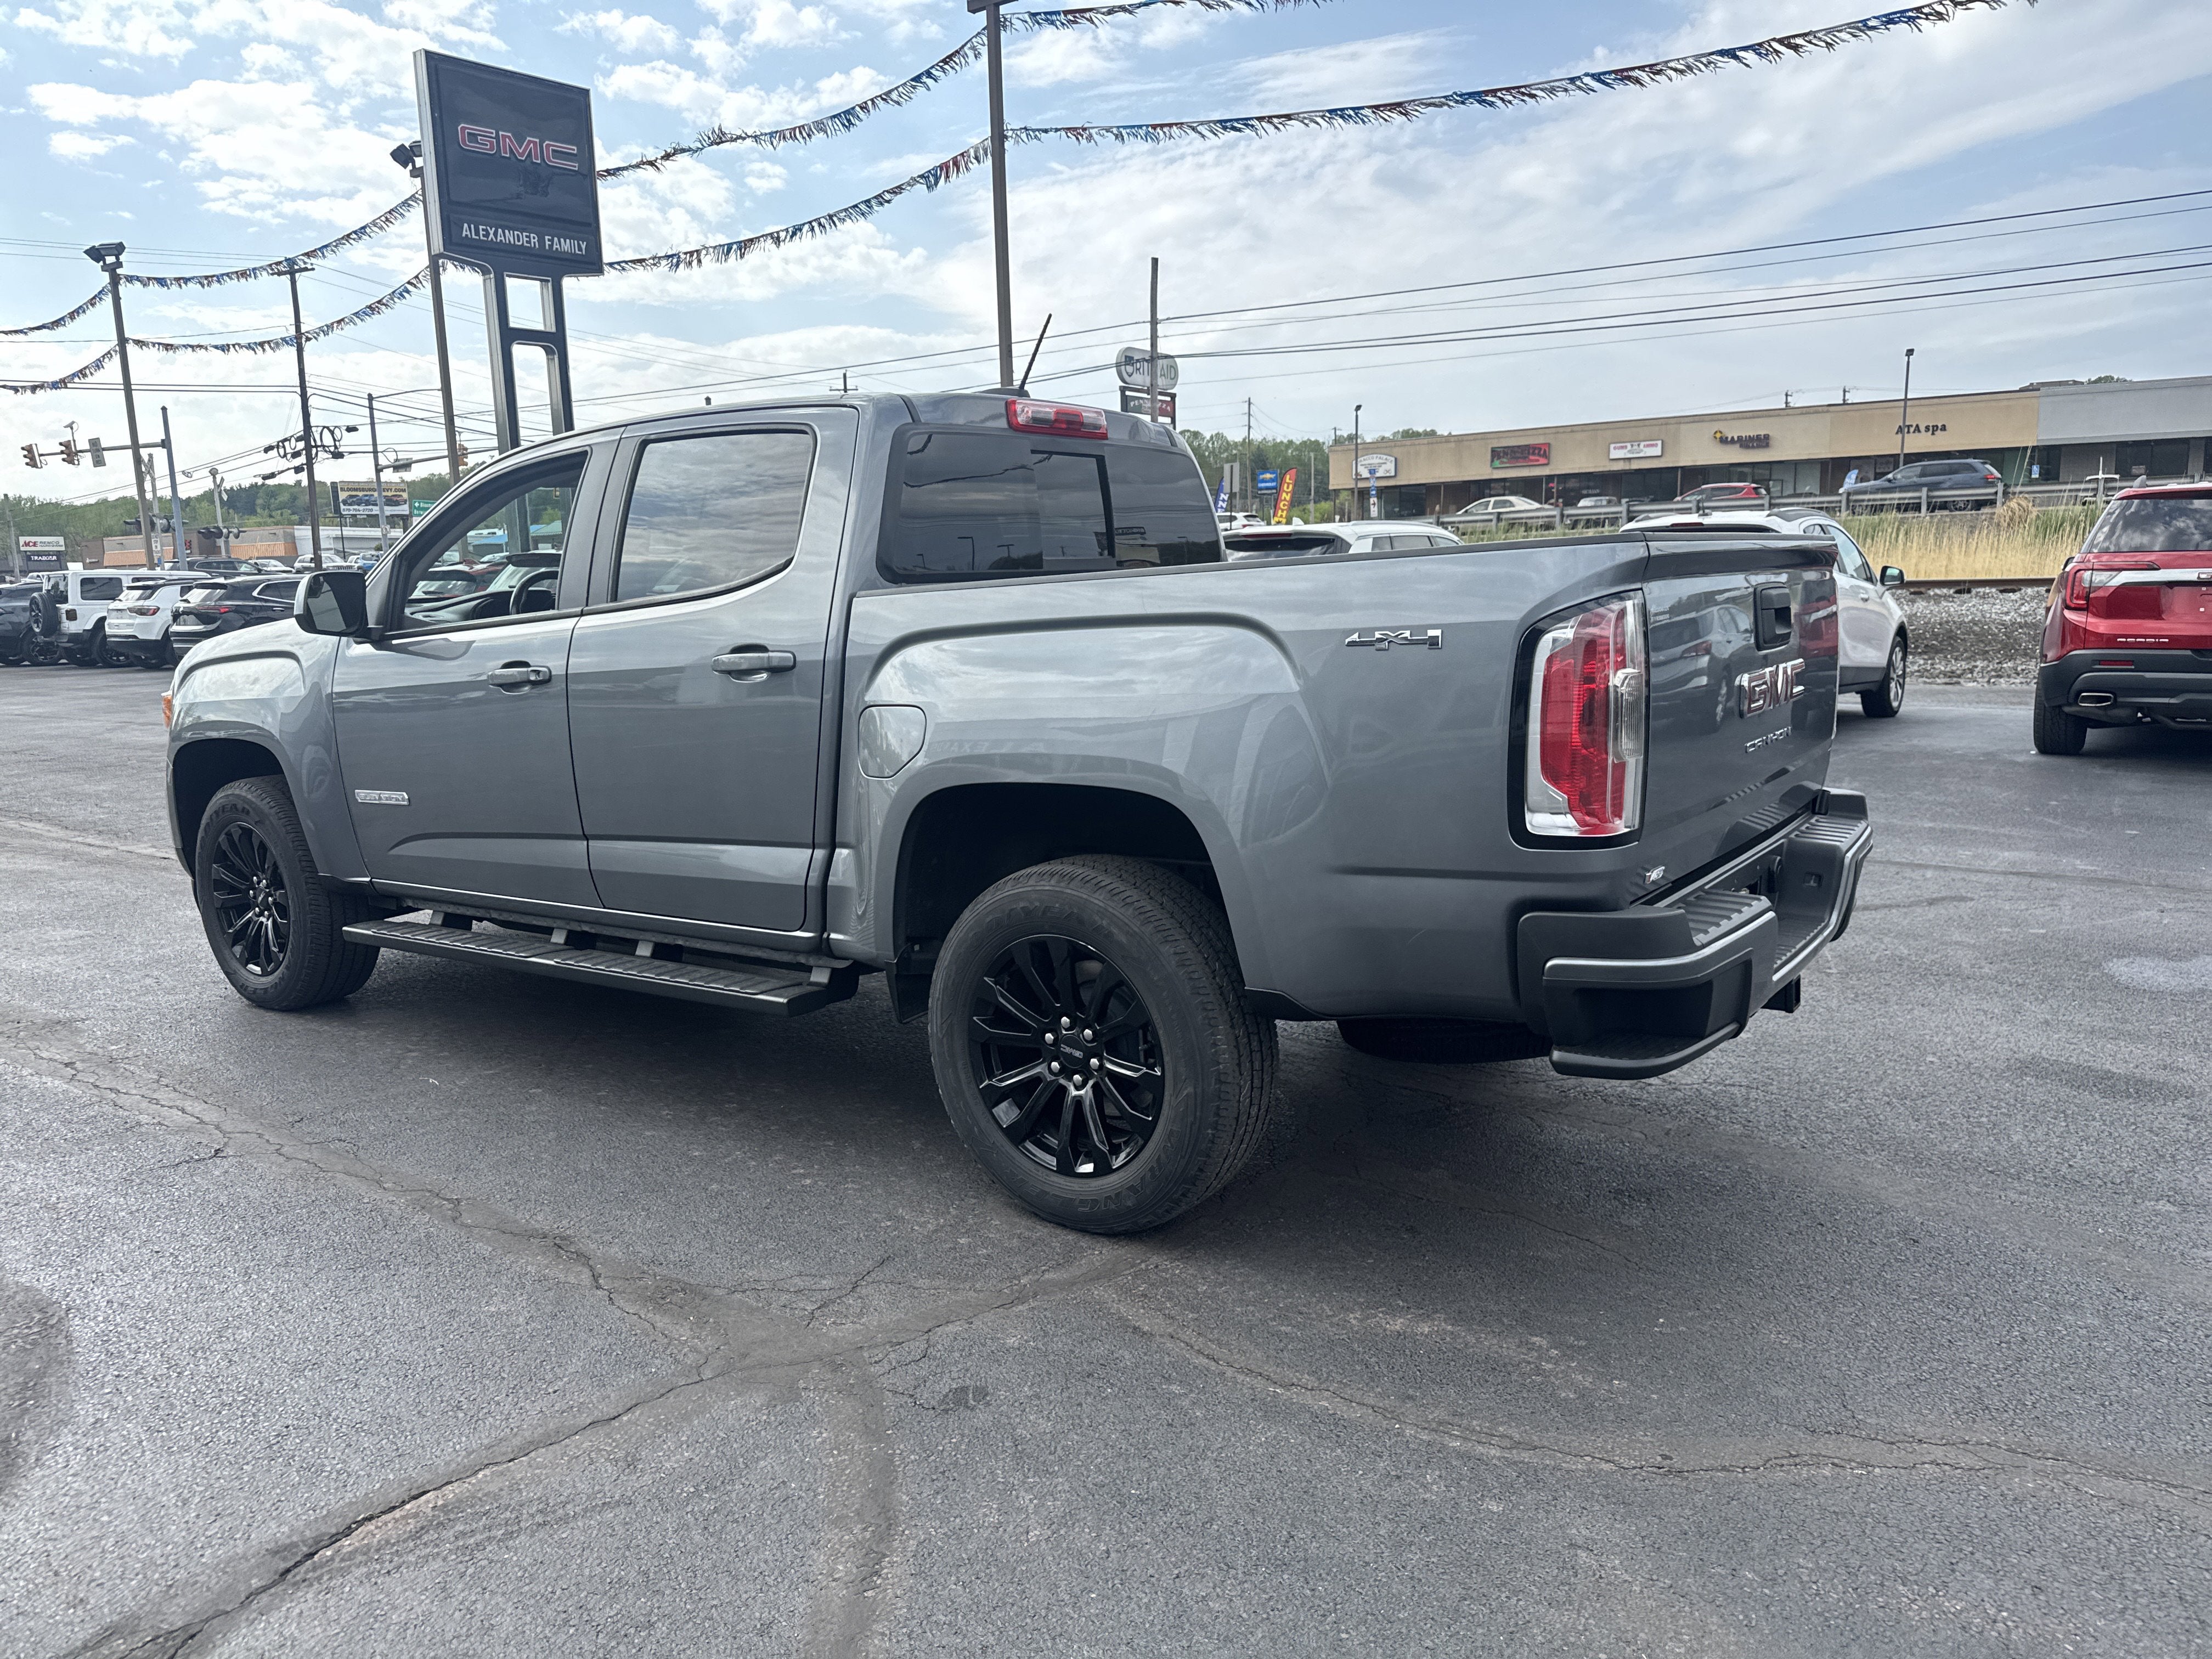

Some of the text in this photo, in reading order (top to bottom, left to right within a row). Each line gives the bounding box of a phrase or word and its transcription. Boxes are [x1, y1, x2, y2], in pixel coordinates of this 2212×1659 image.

[458, 123, 578, 171] GMC
[462, 223, 587, 255] ALEXANDER FAMILY
[1135, 358, 1176, 380] RIT AID
[1895, 424, 1947, 436] ATA spa
[1277, 474, 1293, 518] LUNCH
[1734, 658, 1805, 719] GMC
[1745, 726, 1792, 753] CANYON
[357, 793, 403, 802] ELEVATION
[1060, 1043, 1084, 1059] GMC
